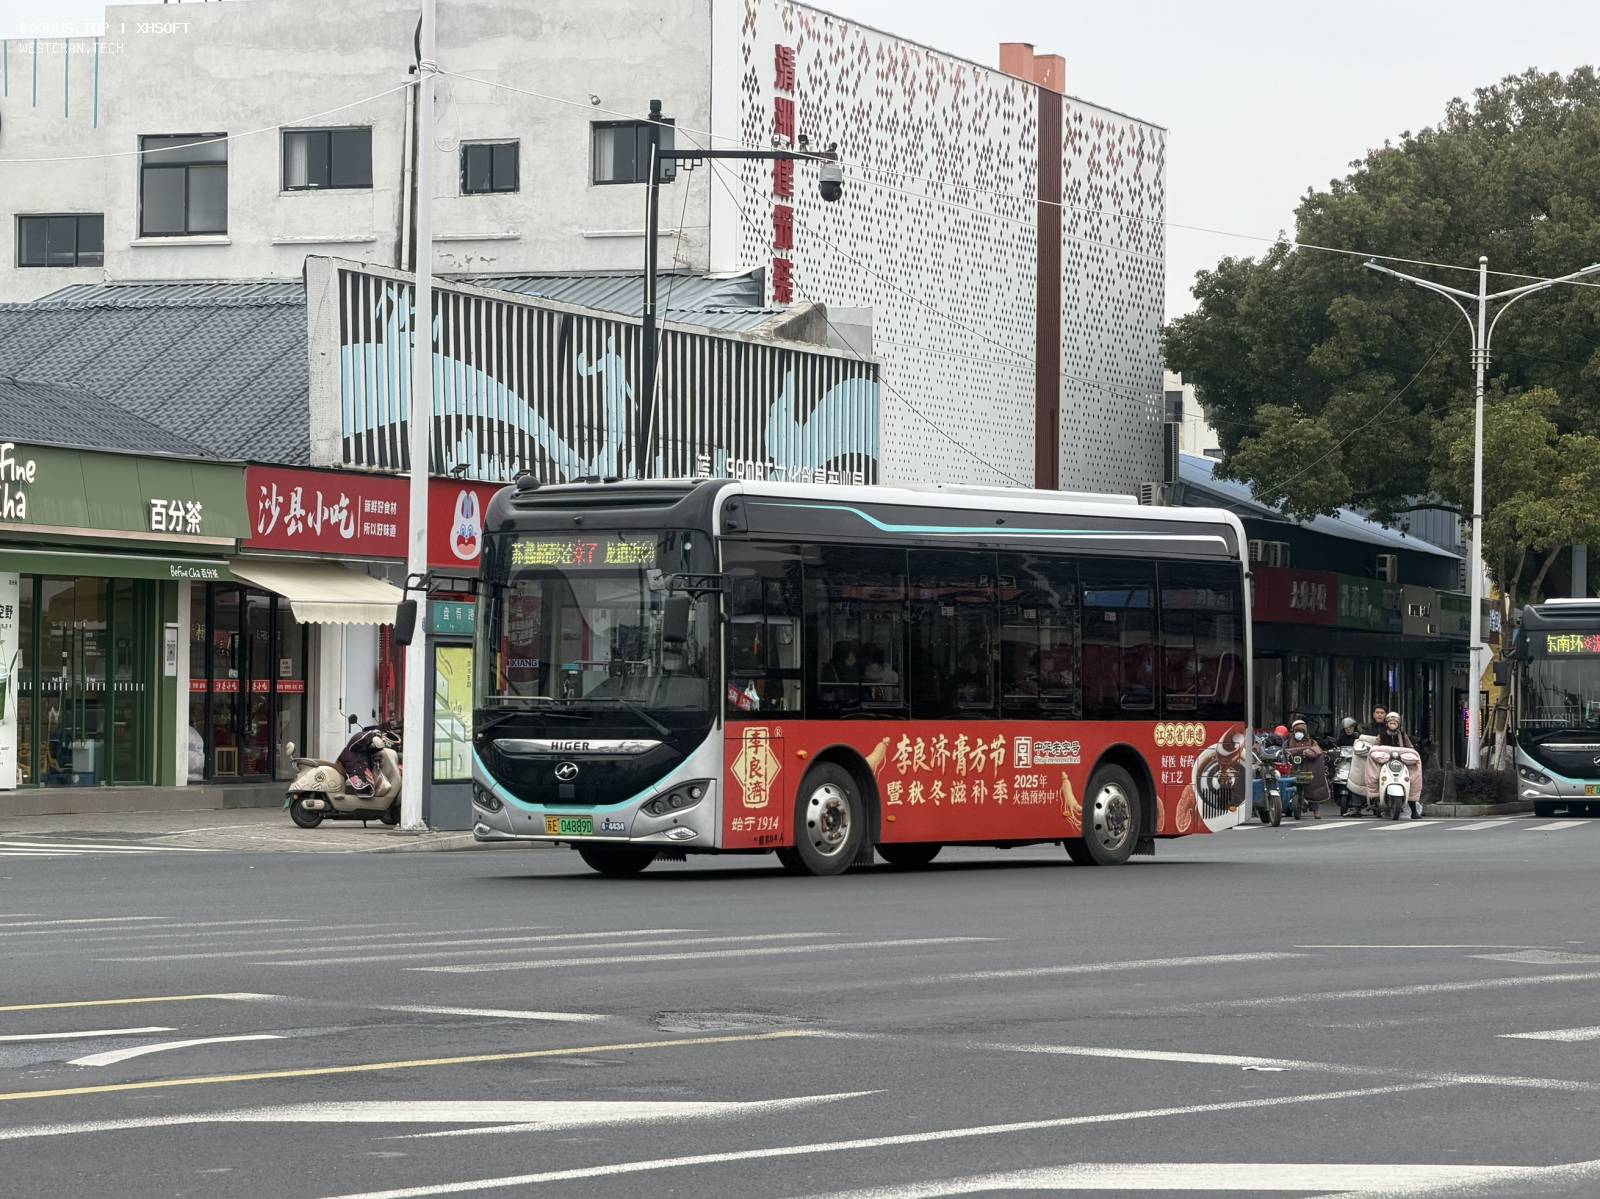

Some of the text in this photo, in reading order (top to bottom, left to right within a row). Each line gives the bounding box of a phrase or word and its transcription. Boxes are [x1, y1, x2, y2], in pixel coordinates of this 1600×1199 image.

[150, 498, 203, 533] 百分茶
[257, 482, 355, 539] 沙县小吃
[364, 499, 397, 516] 新鲜好食材
[363, 522, 397, 538] 所以好味道
[587, 543, 599, 564] 7
[201, 567, 219, 579] 百分茶
[1155, 726, 1205, 745] 江苏省非遗
[551, 741, 590, 751] HIGER
[891, 733, 1007, 777] 李良济膏方节
[1014, 773, 1048, 789] 2025年
[1161, 771, 1184, 784] 好工艺
[886, 779, 1009, 807] 暨秋冬滋补季
